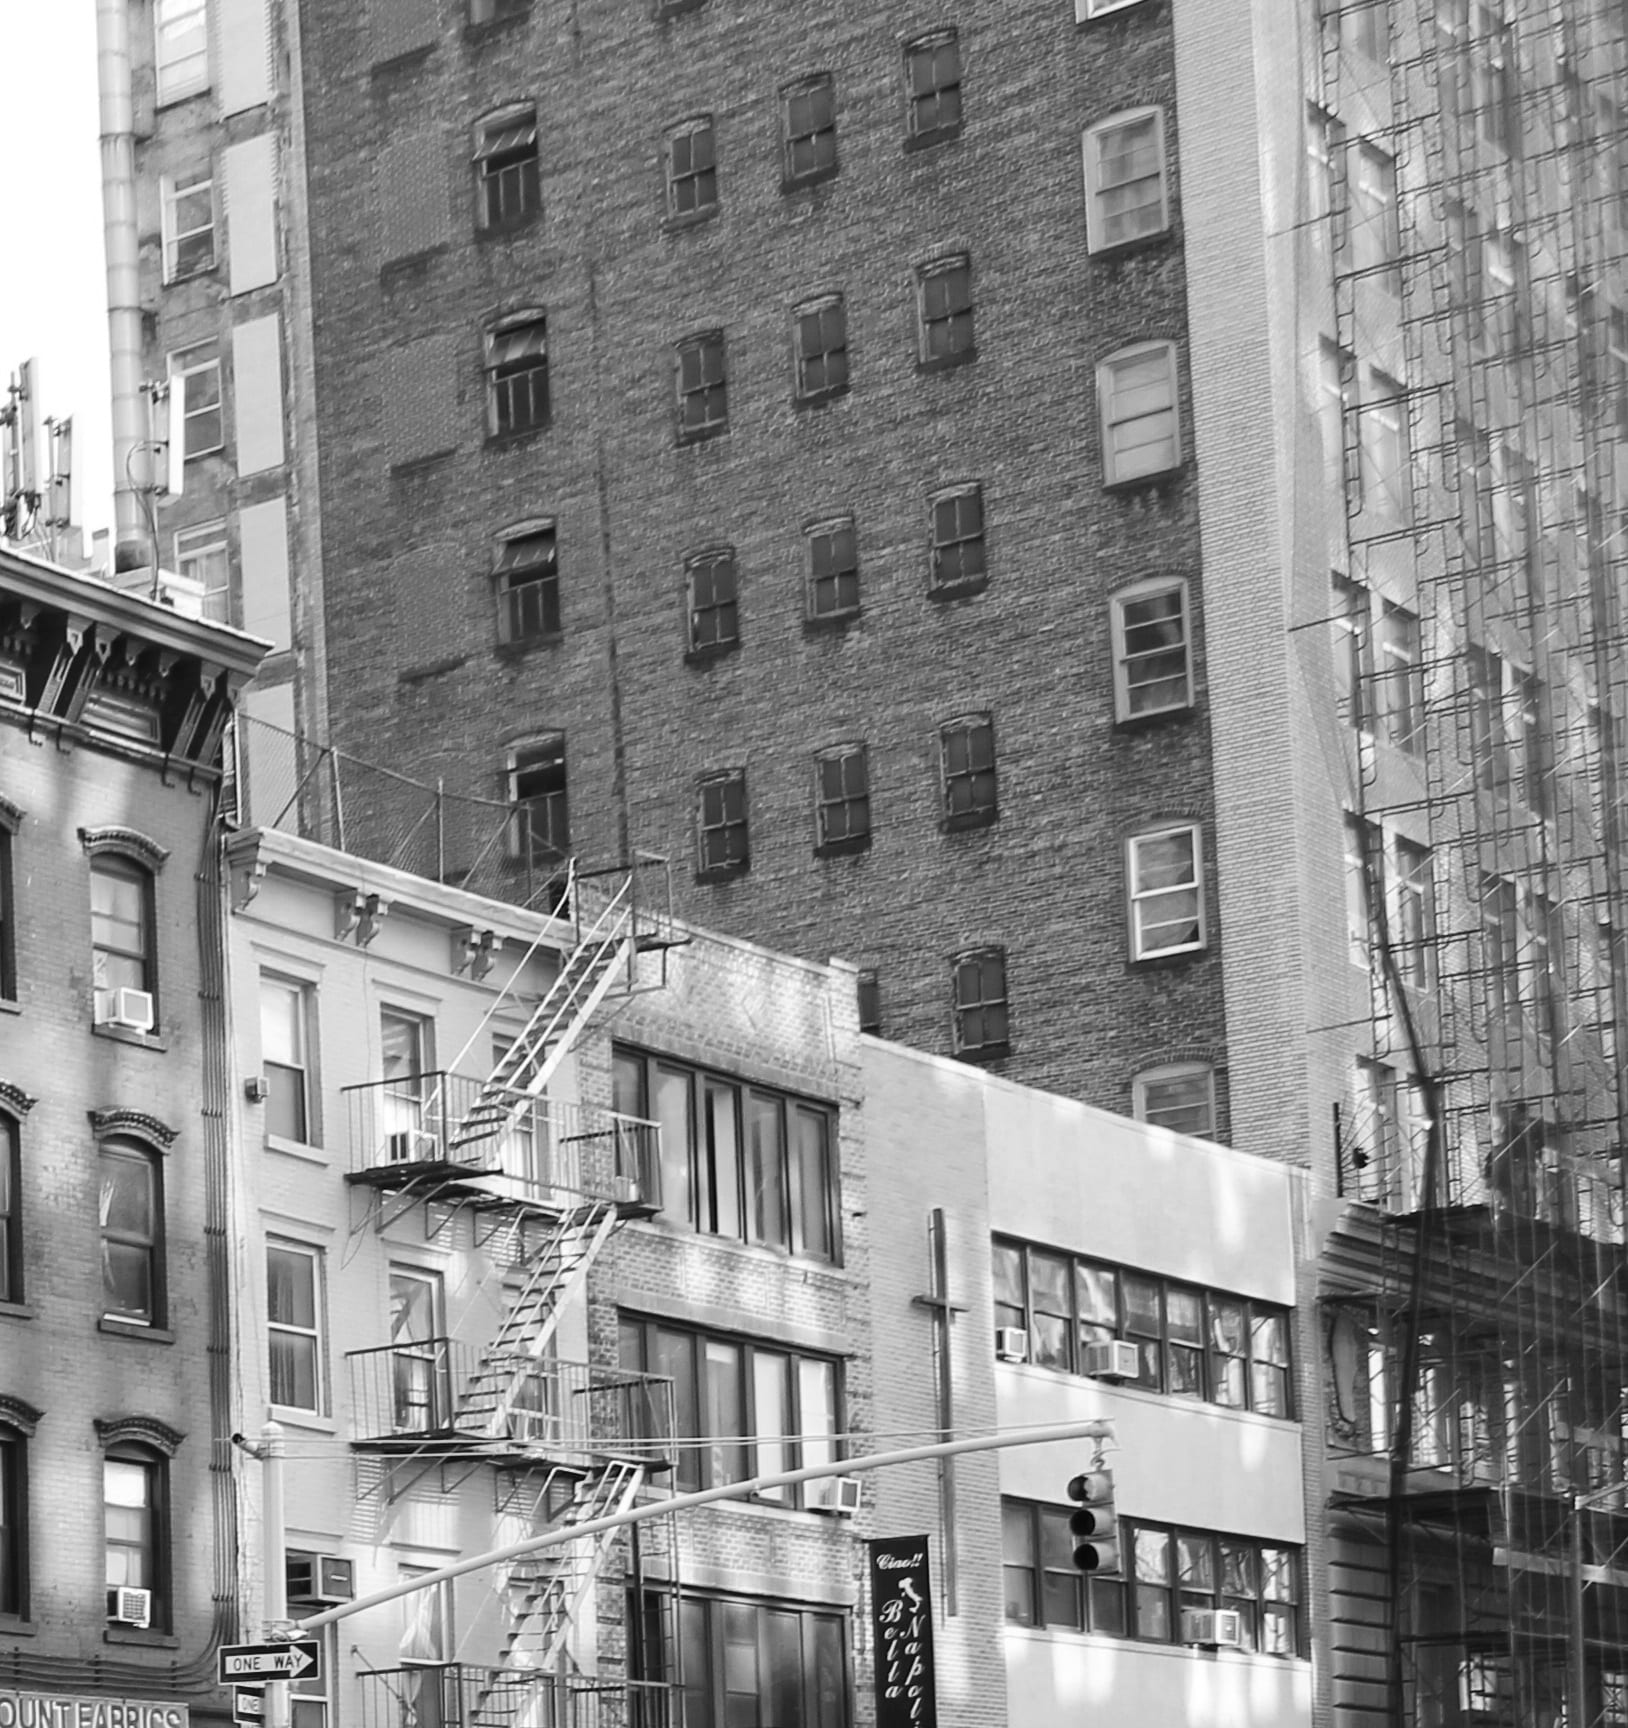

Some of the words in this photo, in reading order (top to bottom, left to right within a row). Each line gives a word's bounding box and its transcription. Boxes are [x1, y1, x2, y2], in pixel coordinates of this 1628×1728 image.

[233, 1656, 262, 1671] ONE
[273, 1653, 304, 1669] WAY
[878, 1599, 904, 1699] Bella
